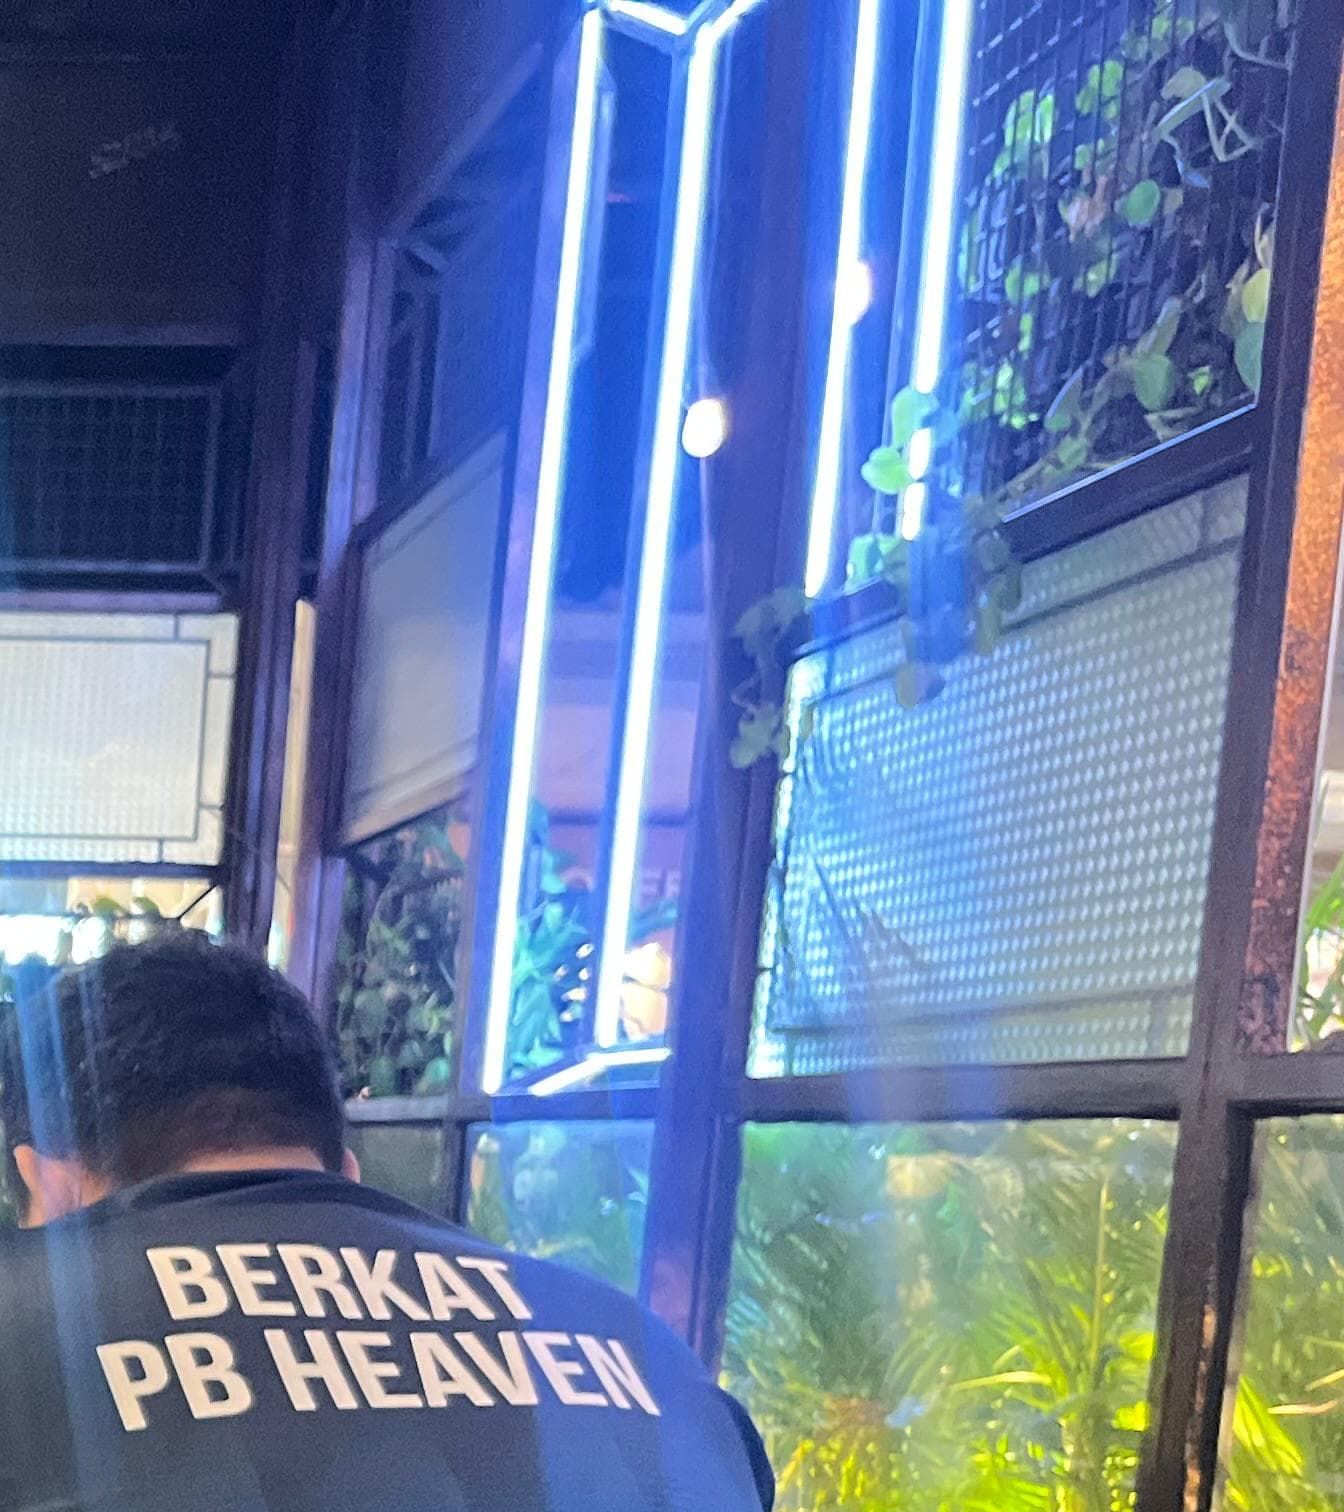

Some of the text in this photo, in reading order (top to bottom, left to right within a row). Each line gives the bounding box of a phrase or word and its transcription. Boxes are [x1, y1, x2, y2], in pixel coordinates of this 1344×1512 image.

[146, 1242, 533, 1322] BERKAT
[96, 1328, 663, 1433] PB HEAVEN
